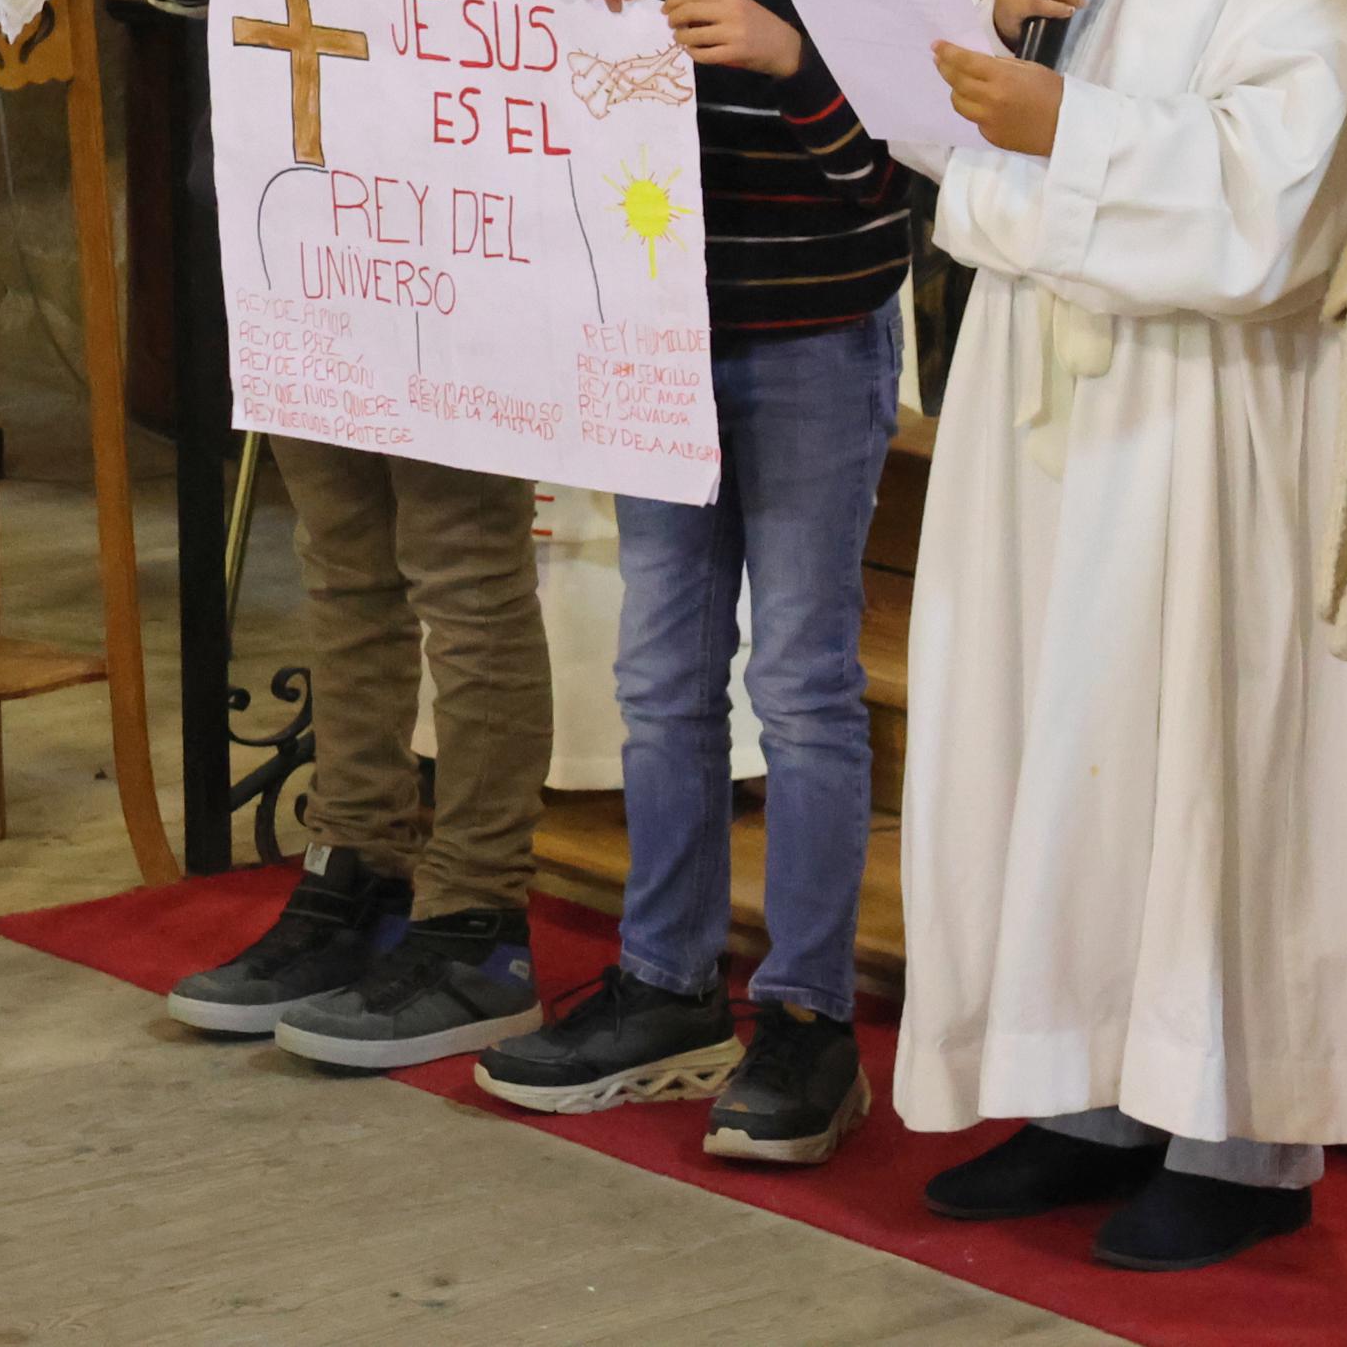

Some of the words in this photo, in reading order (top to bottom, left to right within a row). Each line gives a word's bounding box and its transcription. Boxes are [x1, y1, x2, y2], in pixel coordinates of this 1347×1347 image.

[434, 88, 482, 145] ES
[505, 97, 571, 156] EL
[331, 170, 430, 246] REY
[452, 188, 531, 264] DEL
[239, 320, 270, 346] REY
[273, 331, 298, 351] DE
[302, 330, 342, 356] PAZ
[583, 319, 628, 355] REY
[636, 324, 708, 356] HUMILDE
[238, 346, 271, 371] REY
[274, 356, 297, 376] DE
[577, 353, 608, 375] REY
[637, 363, 700, 387] SENCILLO
[240, 374, 272, 397] REY
[275, 383, 301, 408] QUE
[304, 384, 338, 408] NOS
[343, 390, 400, 421] QUIERE
[578, 375, 609, 398] REY
[616, 380, 652, 403] QUE
[244, 397, 274, 422] REY
[334, 415, 413, 445] PROTEGE
[579, 394, 610, 420] REY
[619, 403, 690, 426] SALVADOR
[582, 421, 617, 446] REY
